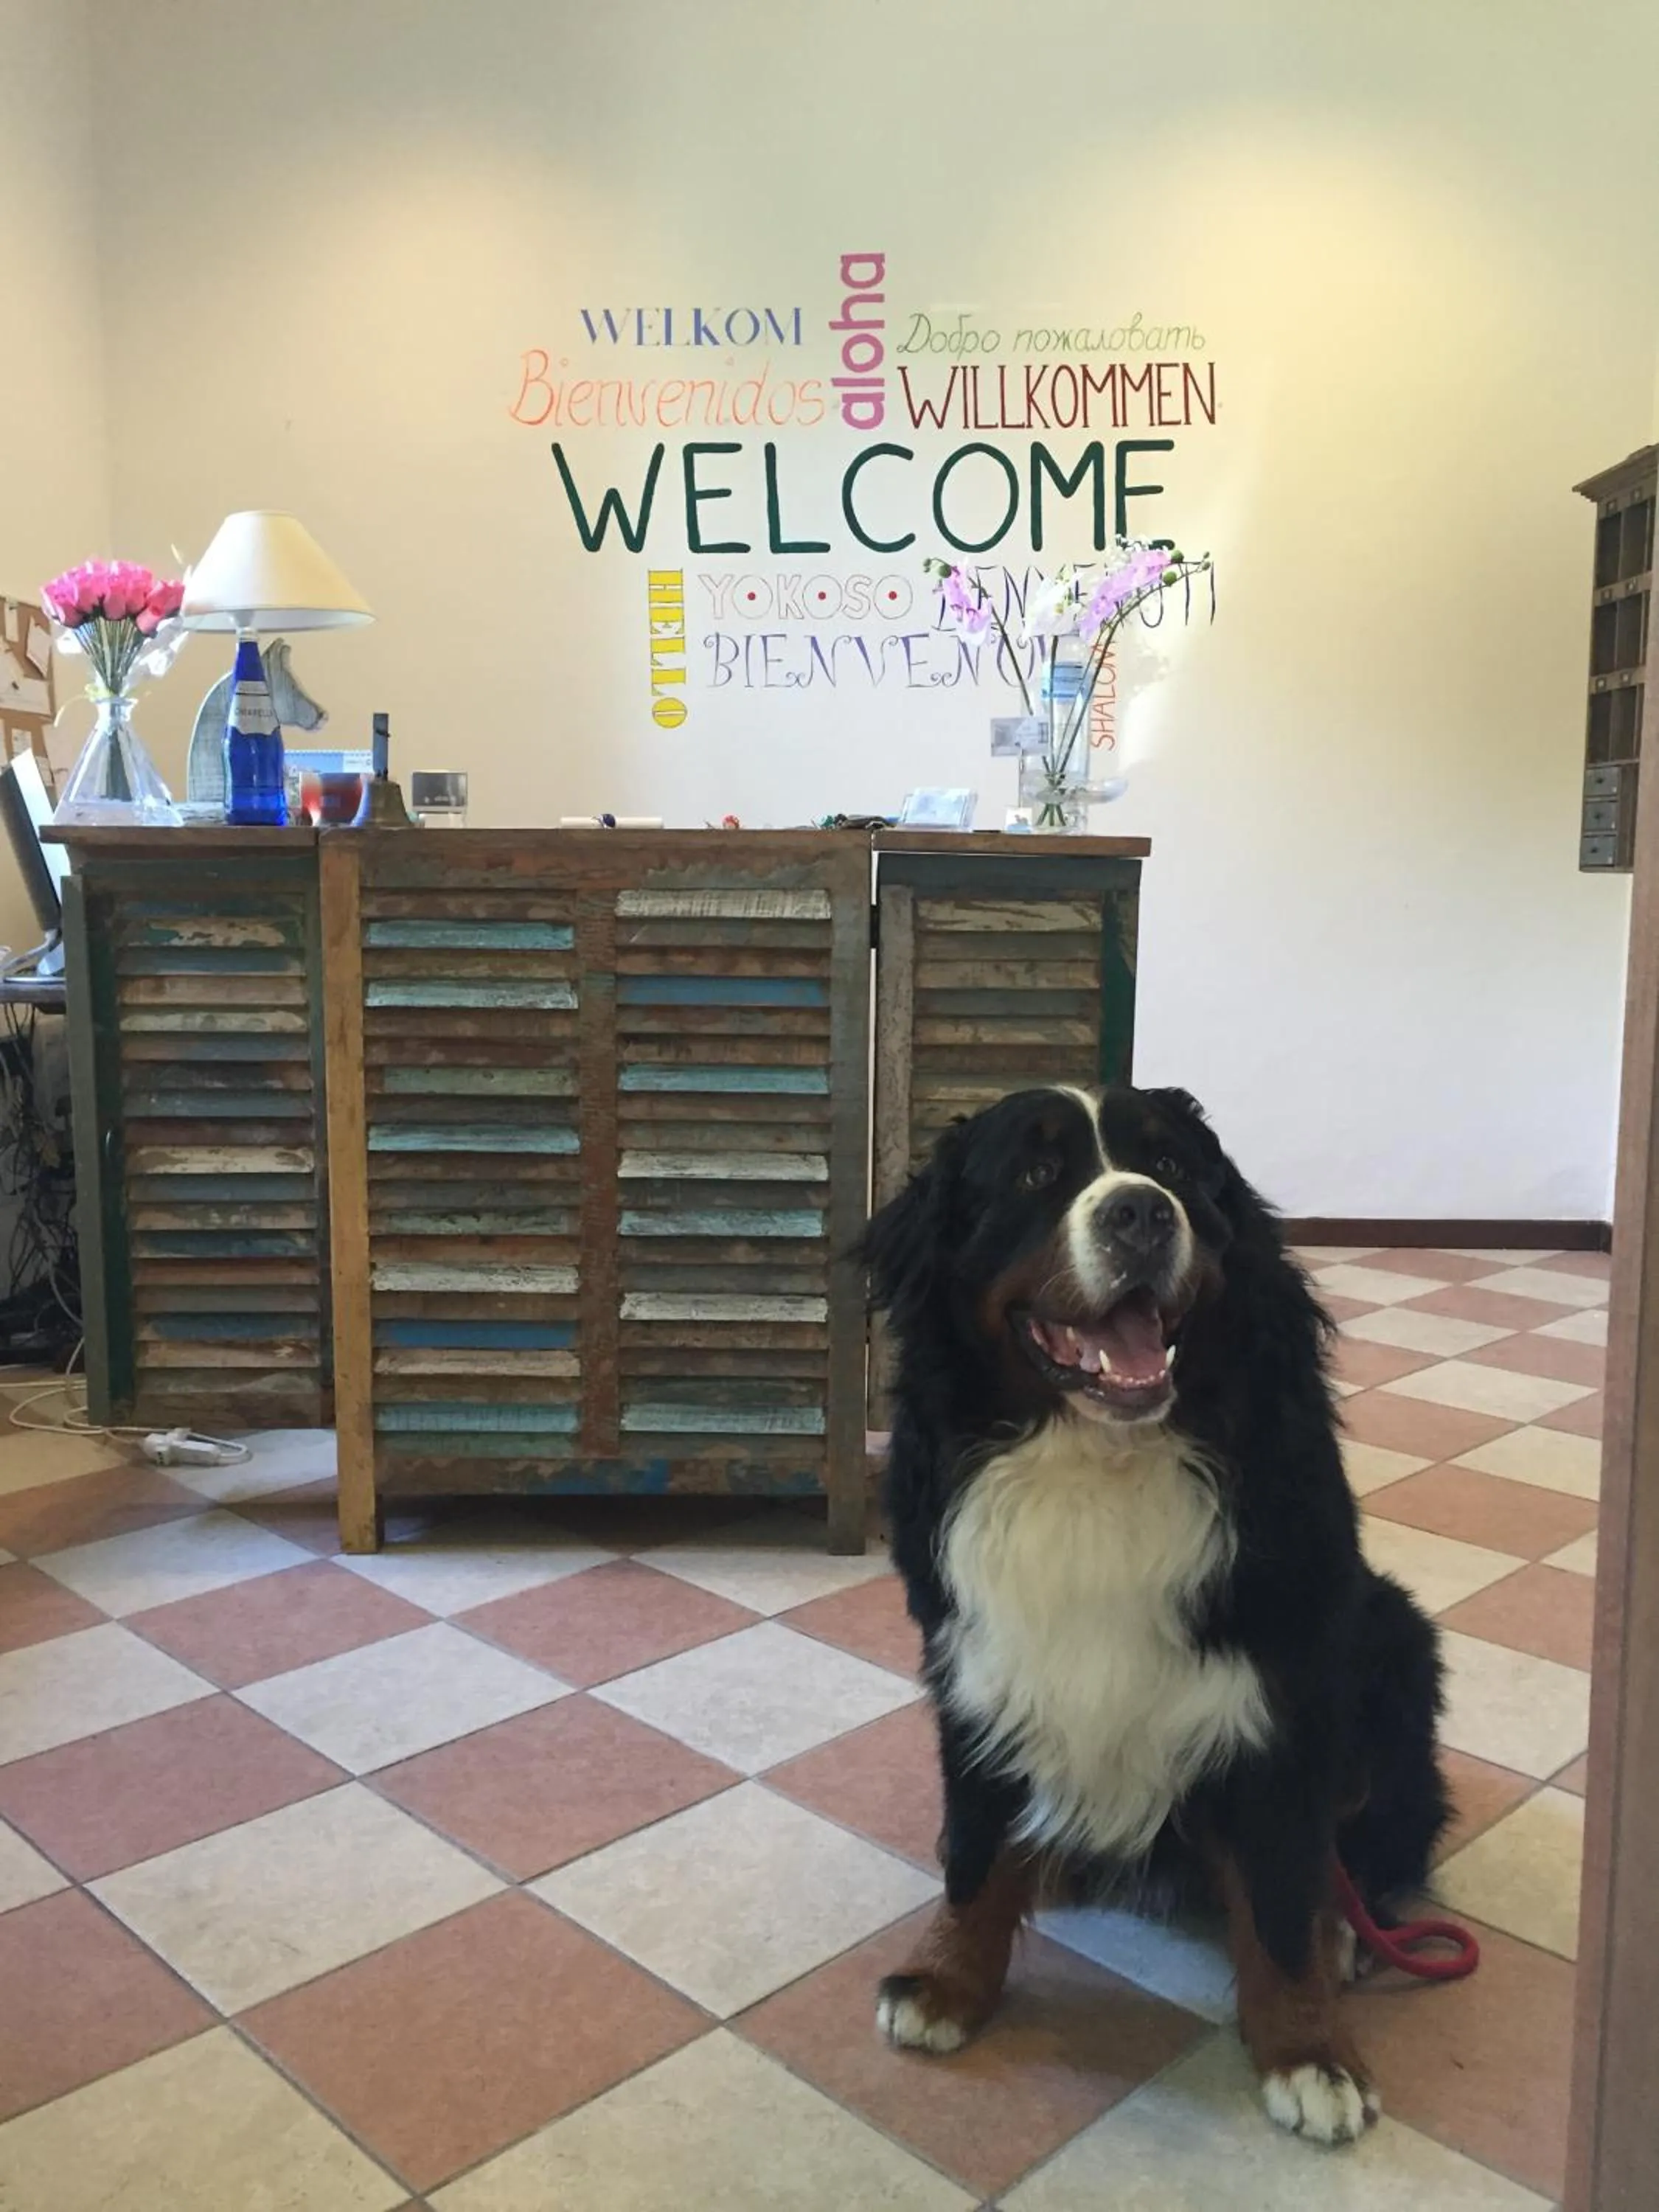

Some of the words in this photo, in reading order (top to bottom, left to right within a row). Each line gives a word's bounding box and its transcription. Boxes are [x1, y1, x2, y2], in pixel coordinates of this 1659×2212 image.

[580, 307, 803, 347] WELKOM
[828, 252, 885, 431] aloha
[896, 312, 1001, 361] Добро
[1012, 312, 1206, 352] пожаловать
[508, 349, 825, 428] Bienvenidos
[897, 361, 1217, 429] WILLKOMMEN
[551, 439, 1175, 554] WELCOME
[698, 574, 914, 620] YOKOSO
[647, 568, 688, 729] HELLO
